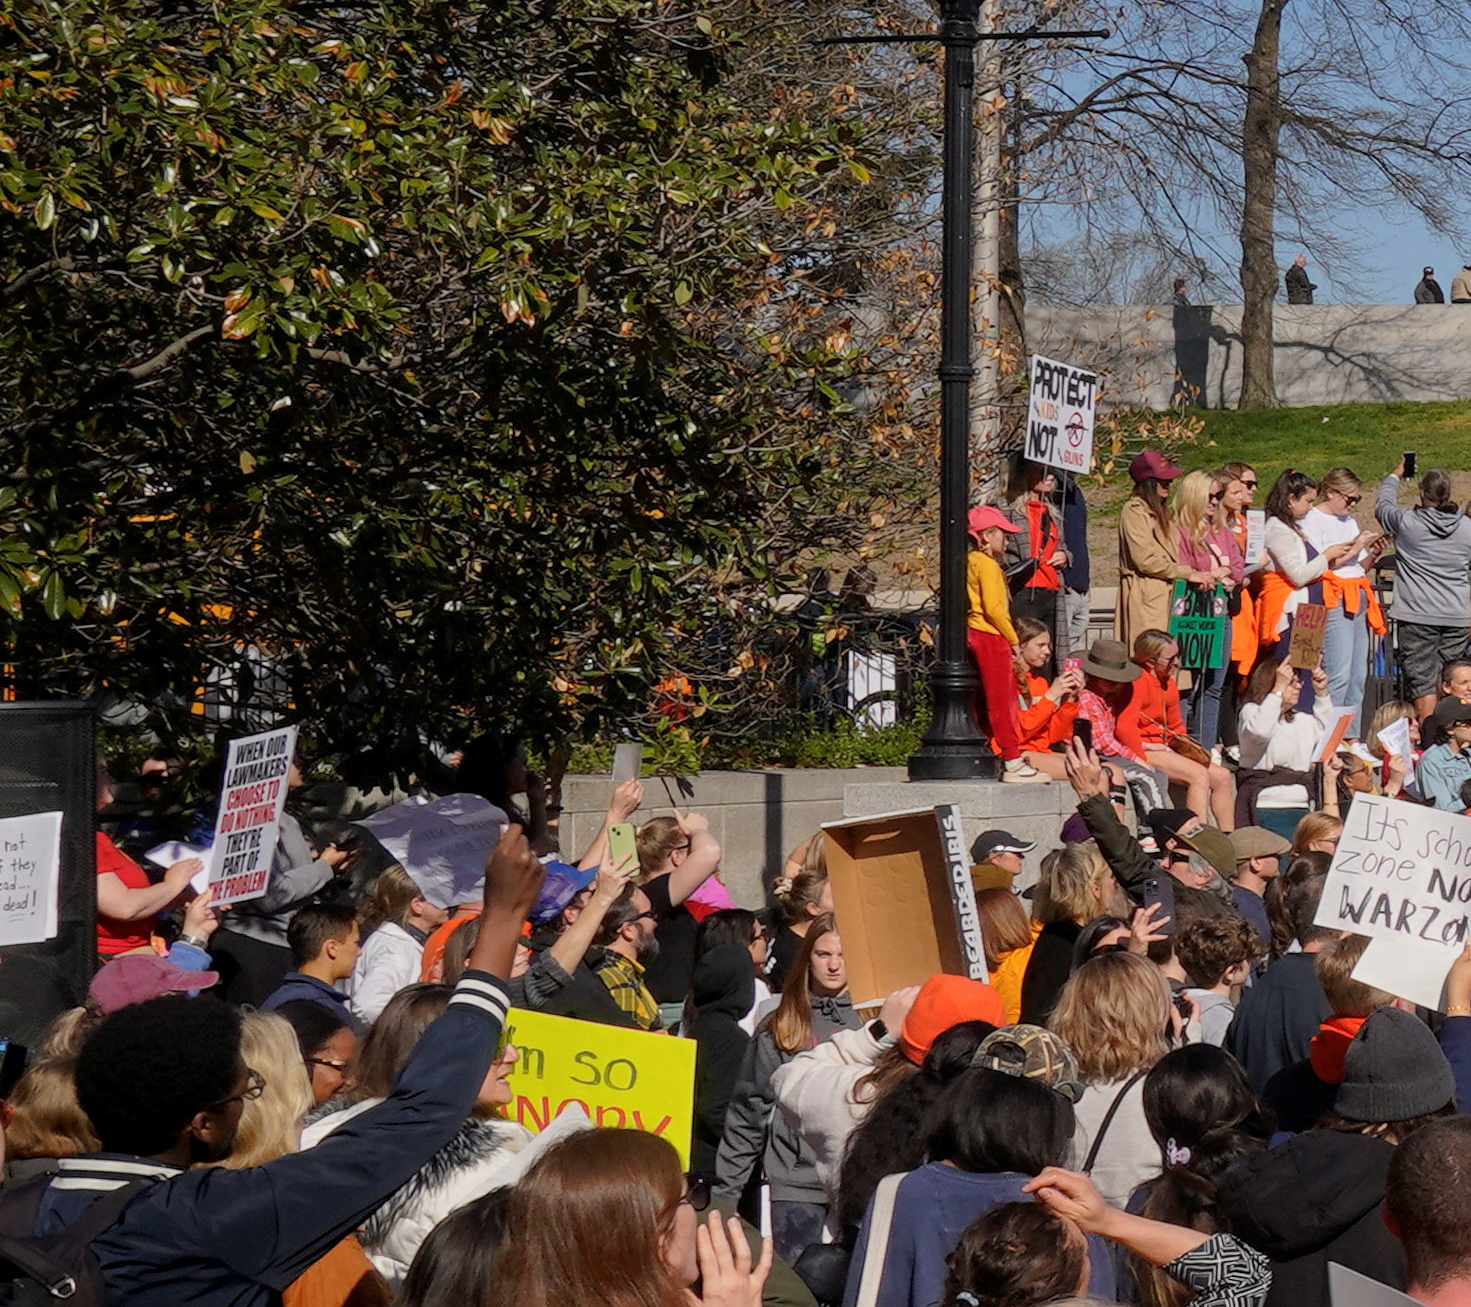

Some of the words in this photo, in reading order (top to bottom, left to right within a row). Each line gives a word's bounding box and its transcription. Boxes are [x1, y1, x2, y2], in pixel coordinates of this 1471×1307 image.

[1033, 360, 1096, 410] PROTECT
[1041, 403, 1058, 421] KIDS
[1029, 420, 1057, 462] NOT
[1064, 450, 1083, 467] GUNS
[1177, 632, 1214, 668] NOW
[236, 741, 264, 765] WHEN
[266, 734, 288, 757] OUR
[226, 755, 289, 789] LAWMAKERS
[226, 783, 266, 811] CHOOSE
[268, 779, 281, 800] TO
[220, 813, 233, 834] DO
[5, 833, 27, 852] not
[226, 827, 264, 854] THEY'RE
[10, 858, 37, 876] they
[221, 854, 245, 878] PART
[247, 850, 260, 871] OF
[224, 870, 268, 898] PROBLEM
[570, 1051, 637, 1091] SO
